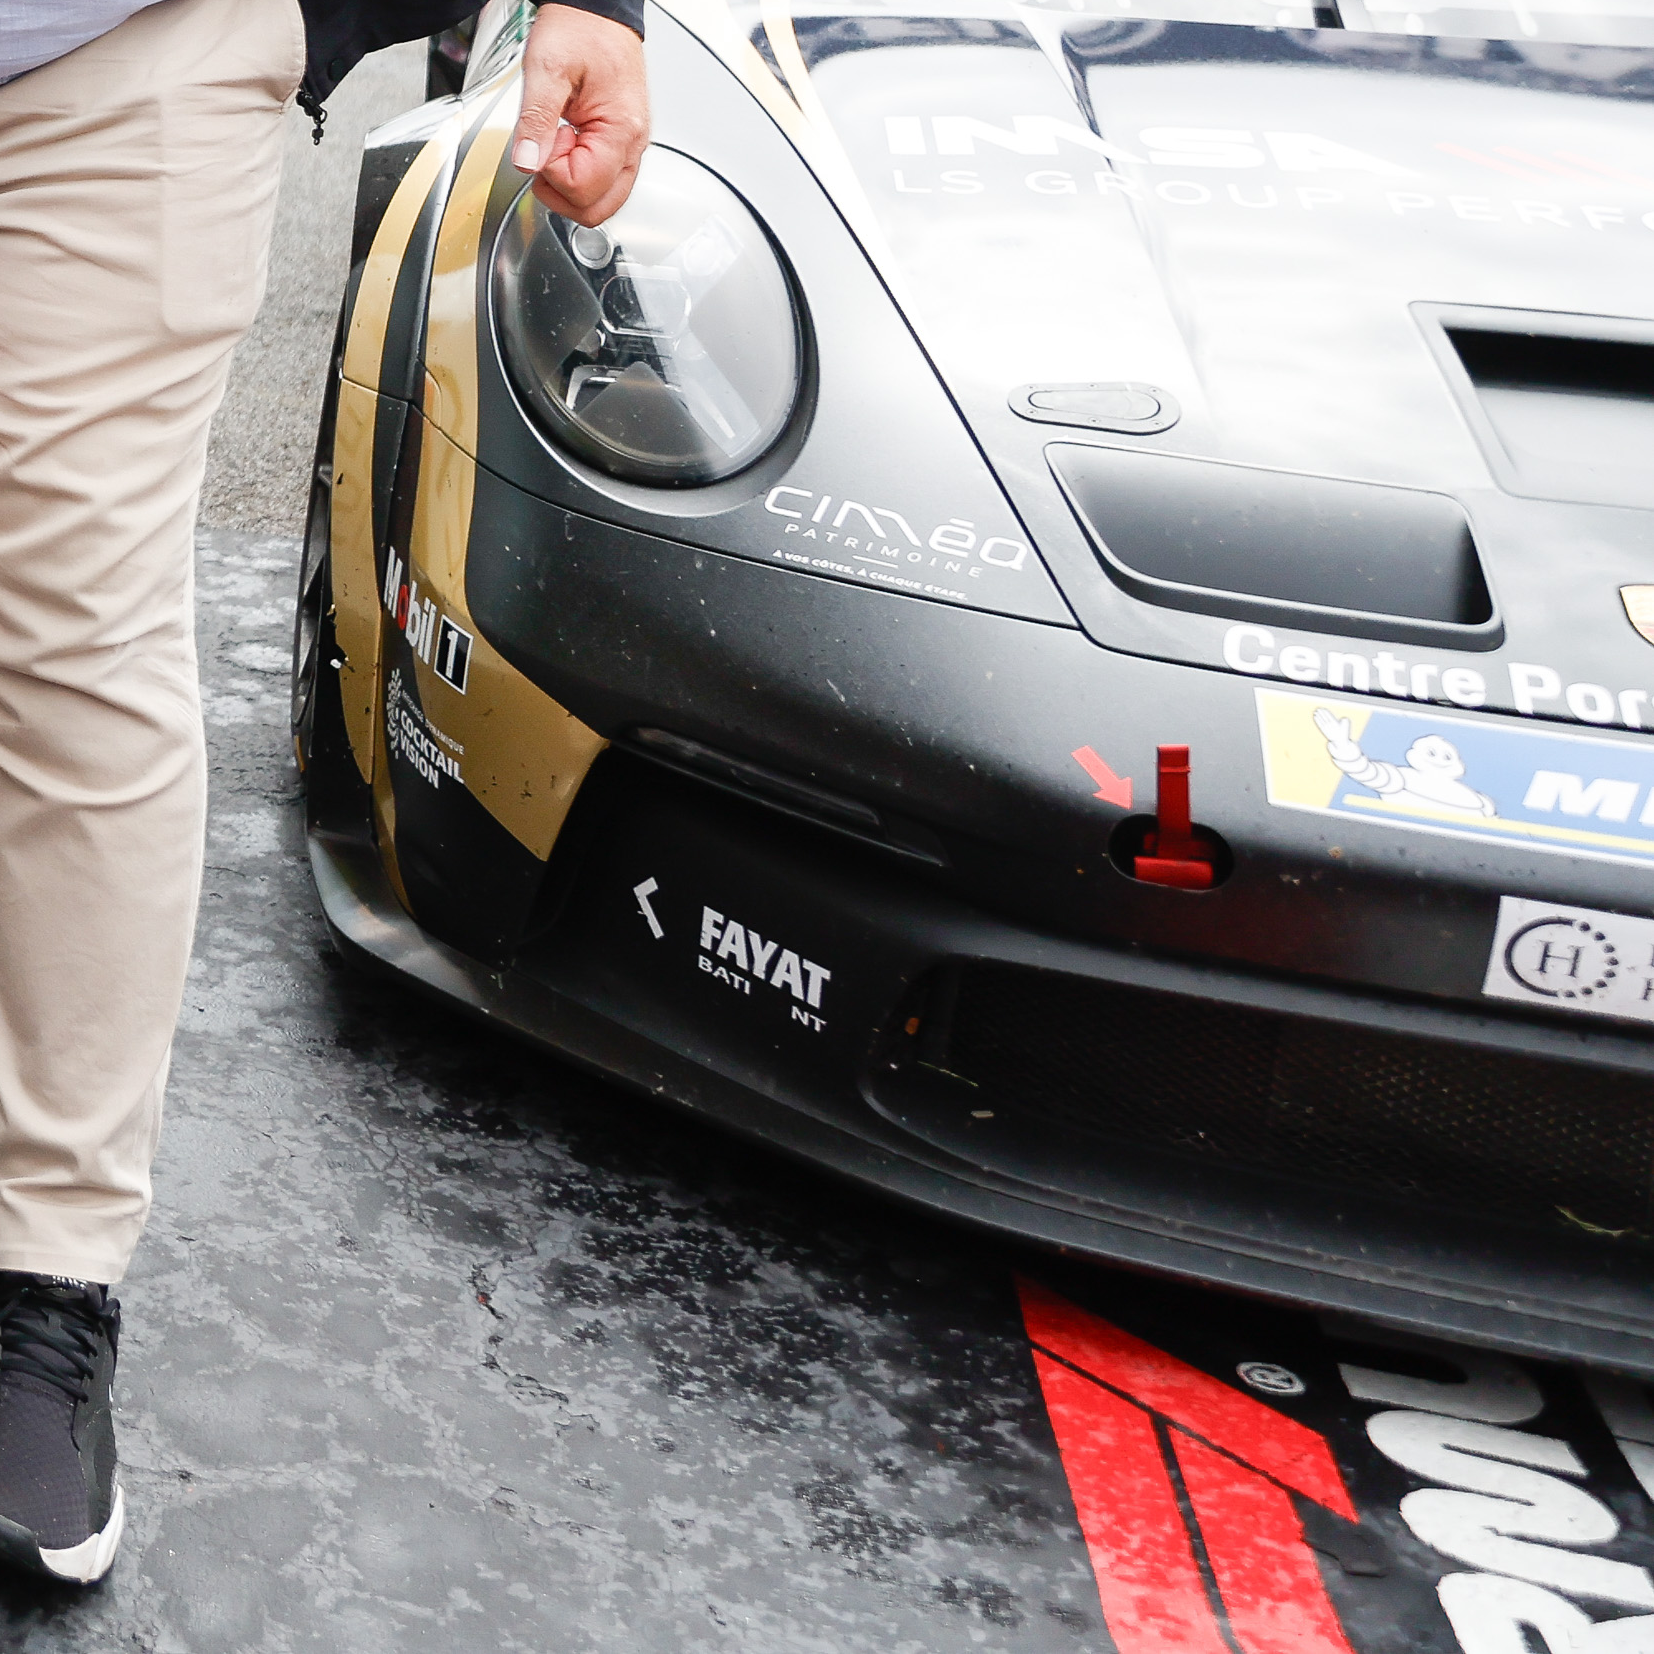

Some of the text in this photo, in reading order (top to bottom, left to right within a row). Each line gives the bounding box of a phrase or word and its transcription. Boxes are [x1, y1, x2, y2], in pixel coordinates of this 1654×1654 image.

[894, 170, 986, 195] LS
[1023, 170, 1346, 212] GROUP
[783, 522, 984, 579] PATRIMOINE
[783, 552, 810, 565] VOS
[869, 571, 921, 590] CHAQUE
[383, 545, 438, 666] Mobil
[1221, 625, 1489, 709] Centre
[398, 727, 440, 789] VISION
[399, 708, 465, 785] COCKTAIL
[699, 905, 832, 1009] FAYAT
